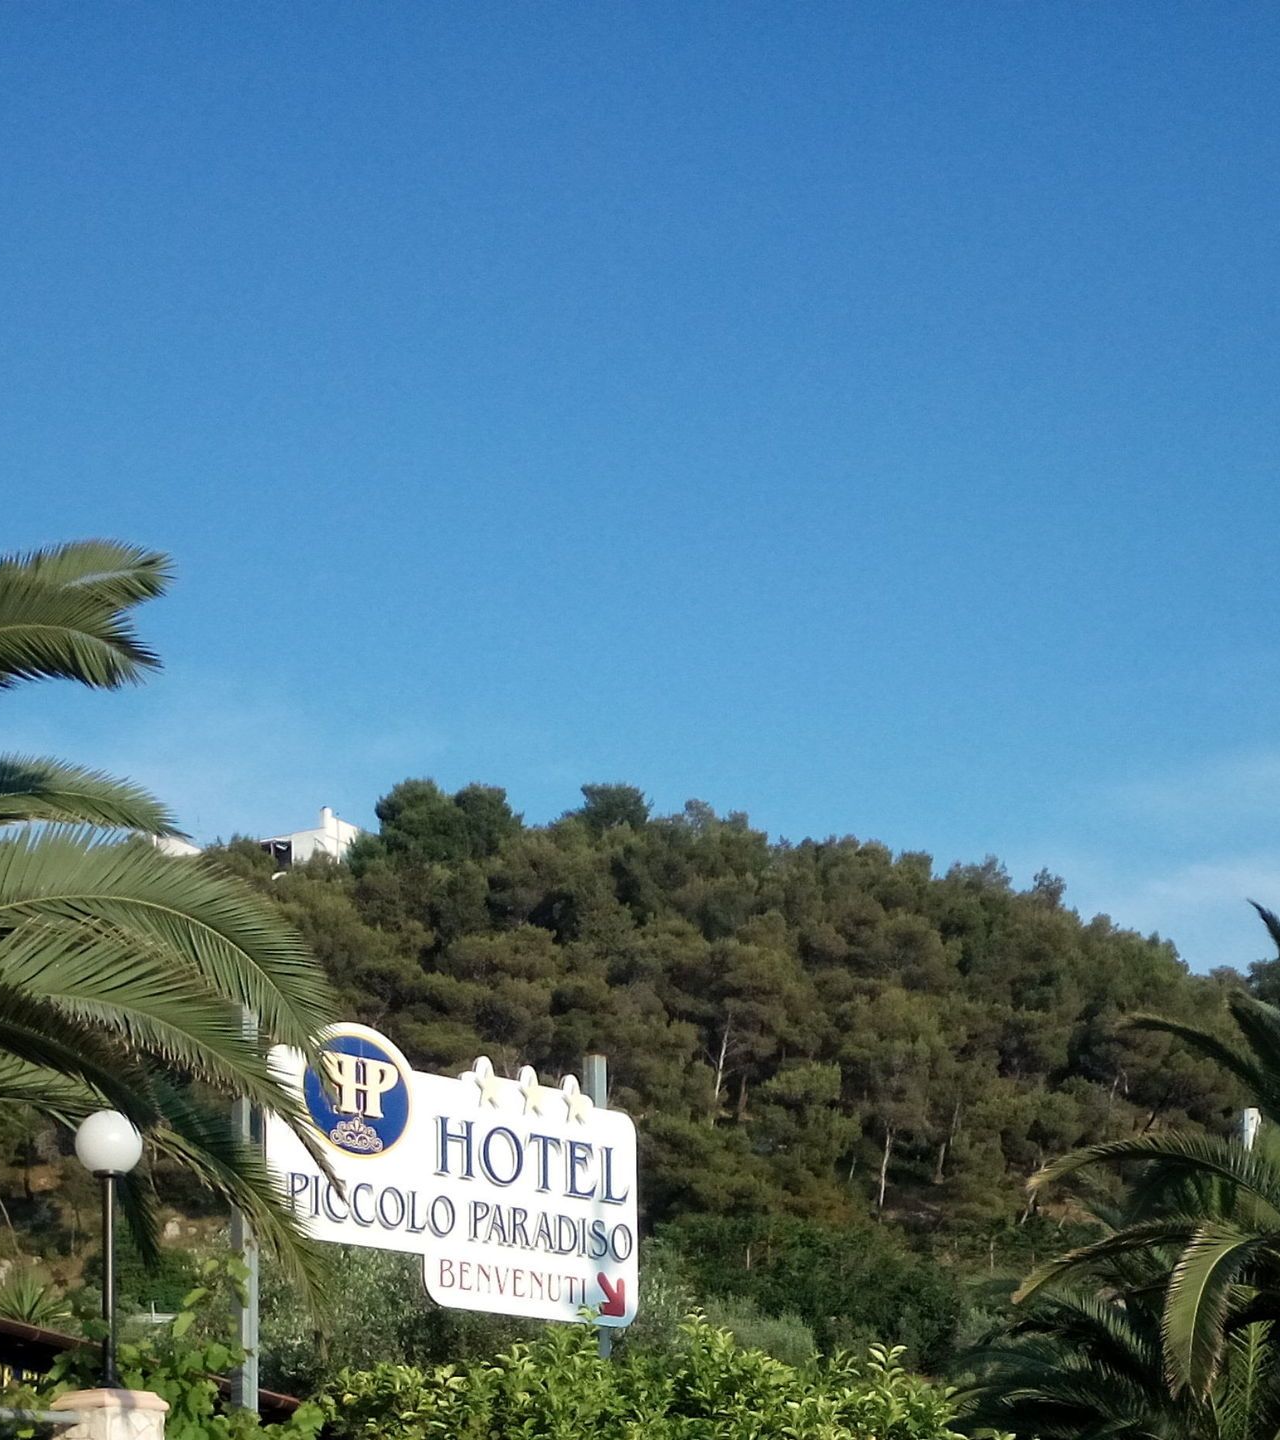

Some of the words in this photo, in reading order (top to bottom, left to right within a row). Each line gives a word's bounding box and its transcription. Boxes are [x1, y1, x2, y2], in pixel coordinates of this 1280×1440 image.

[434, 1116, 629, 1205] HOTEL
[287, 1172, 456, 1238] PICCOLO
[468, 1200, 633, 1263] PARADISO
[439, 1258, 587, 1304] BENVENUTI
